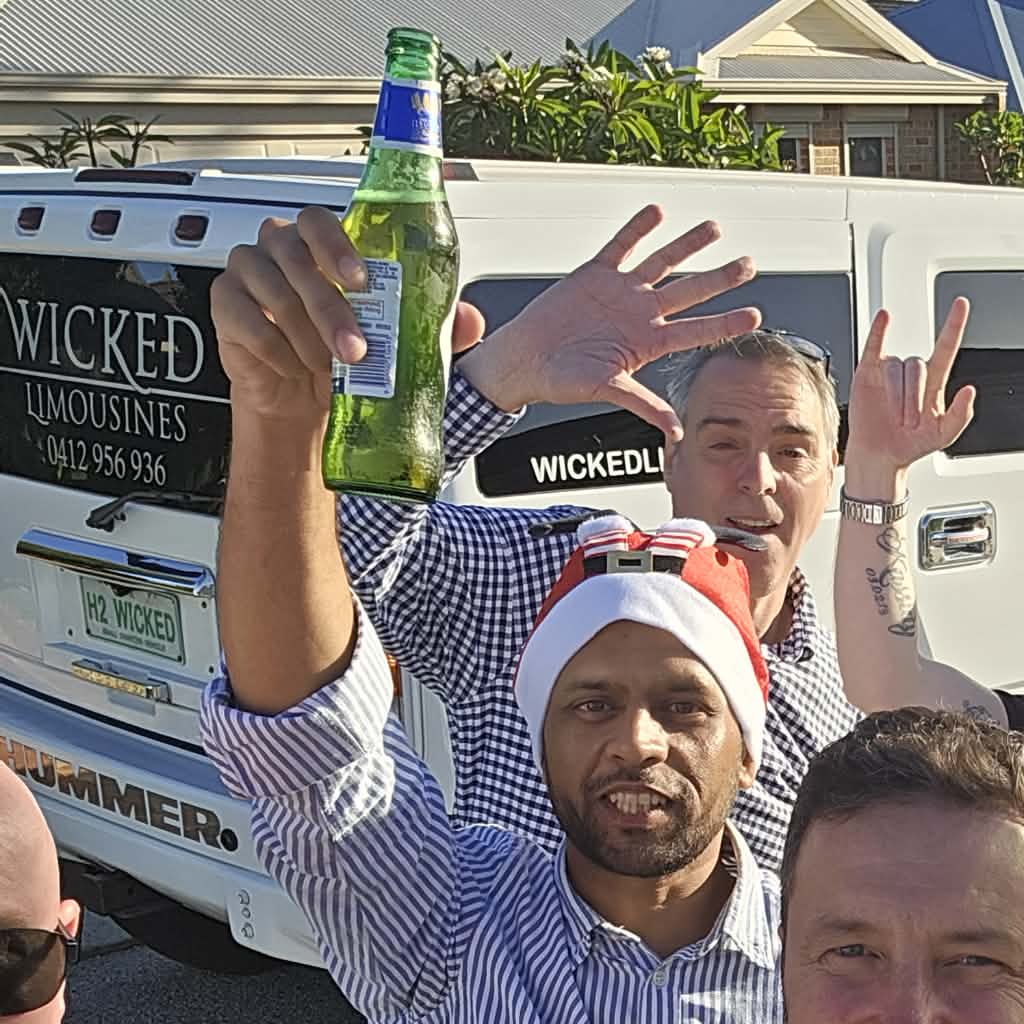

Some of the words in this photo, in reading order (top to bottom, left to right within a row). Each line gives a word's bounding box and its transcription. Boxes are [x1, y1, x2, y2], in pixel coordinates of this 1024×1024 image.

[0, 288, 204, 394] WICKED
[25, 382, 187, 442] LIMOUSINES
[47, 435, 89, 471] 0412
[92, 443, 126, 479] 956
[130, 450, 166, 486] 936
[530, 447, 665, 484] WICKEDLI
[86, 591, 108, 624] H2
[112, 598, 176, 643] WICKED
